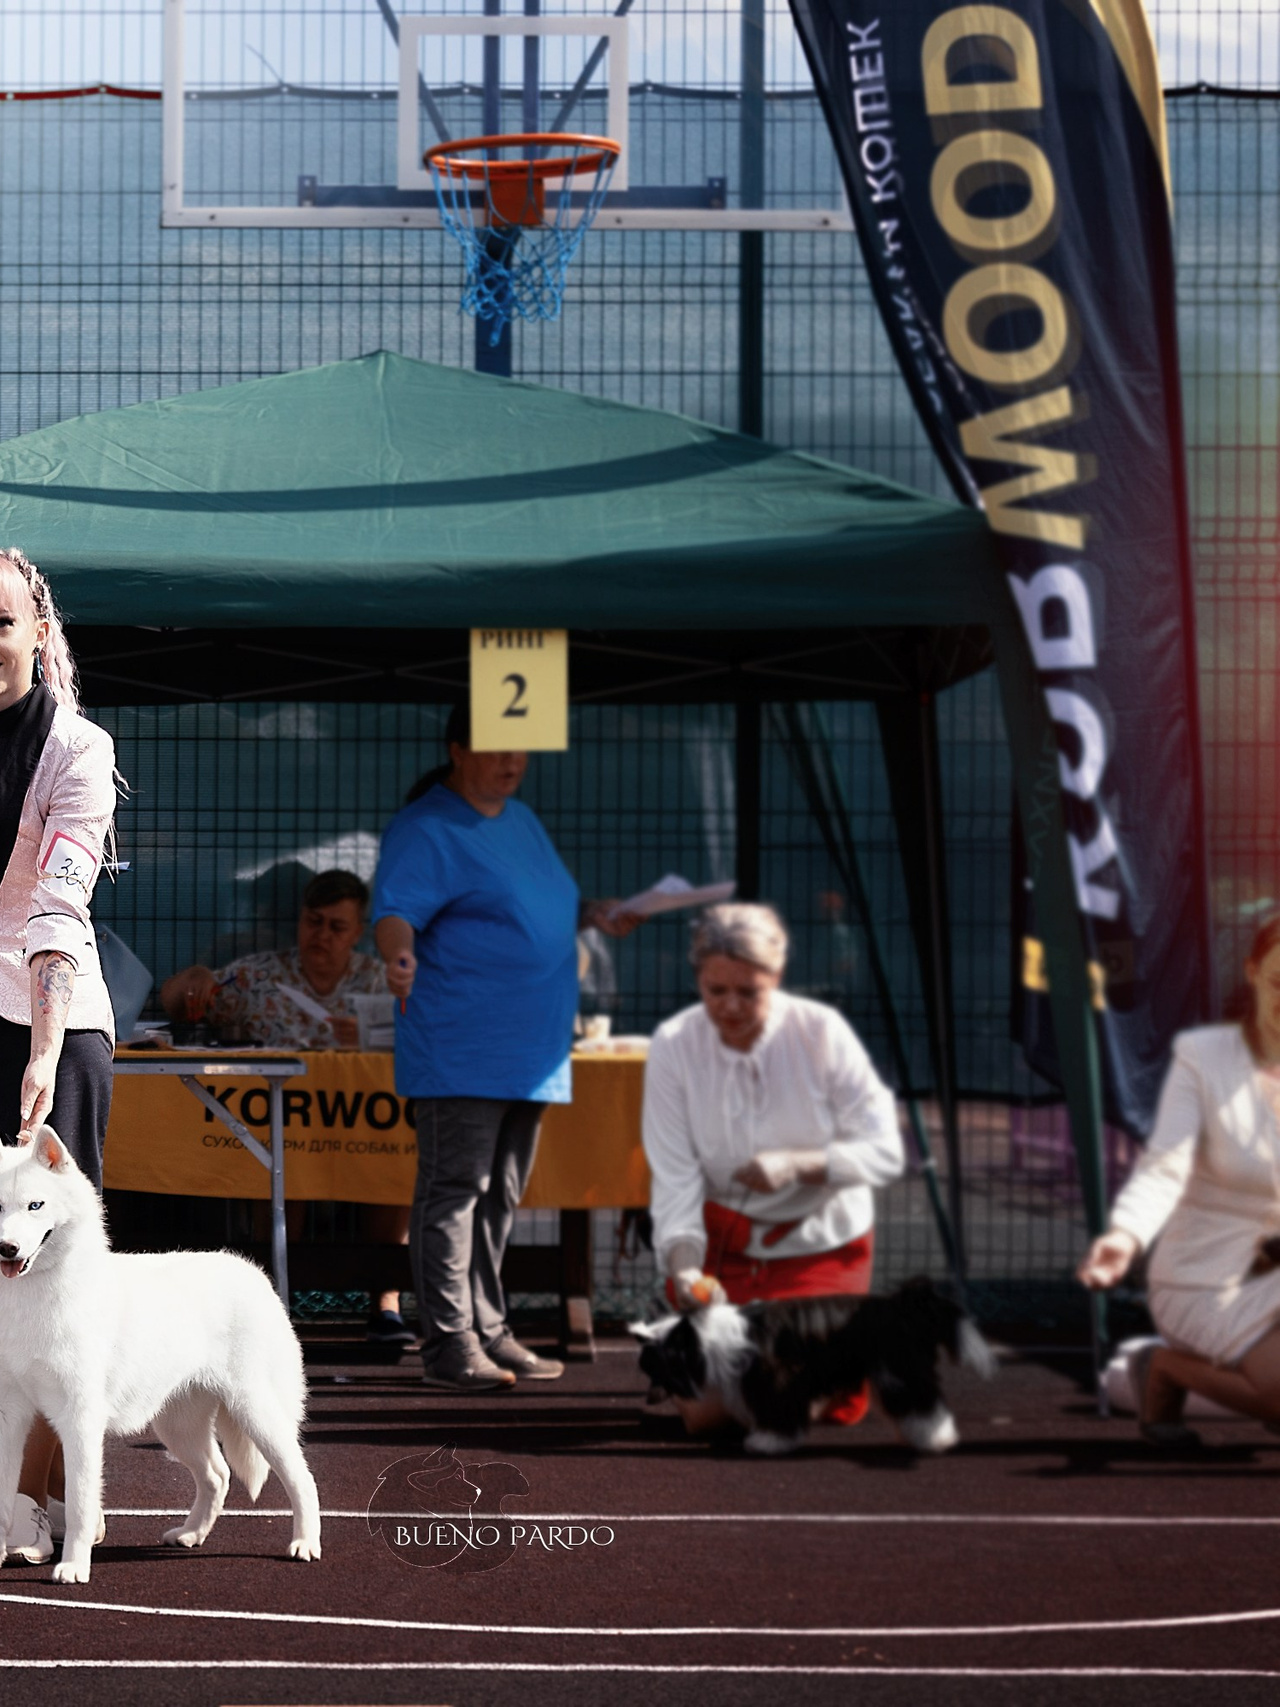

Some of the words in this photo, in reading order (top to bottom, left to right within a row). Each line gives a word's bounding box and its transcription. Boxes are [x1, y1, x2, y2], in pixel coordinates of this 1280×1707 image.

[501, 672, 529, 718] 2
[202, 1134, 249, 1150] СУХО
[259, 1138, 305, 1152] КРМ
[308, 1139, 342, 1154] ДЛЯ
[345, 1140, 399, 1155] СОБАК
